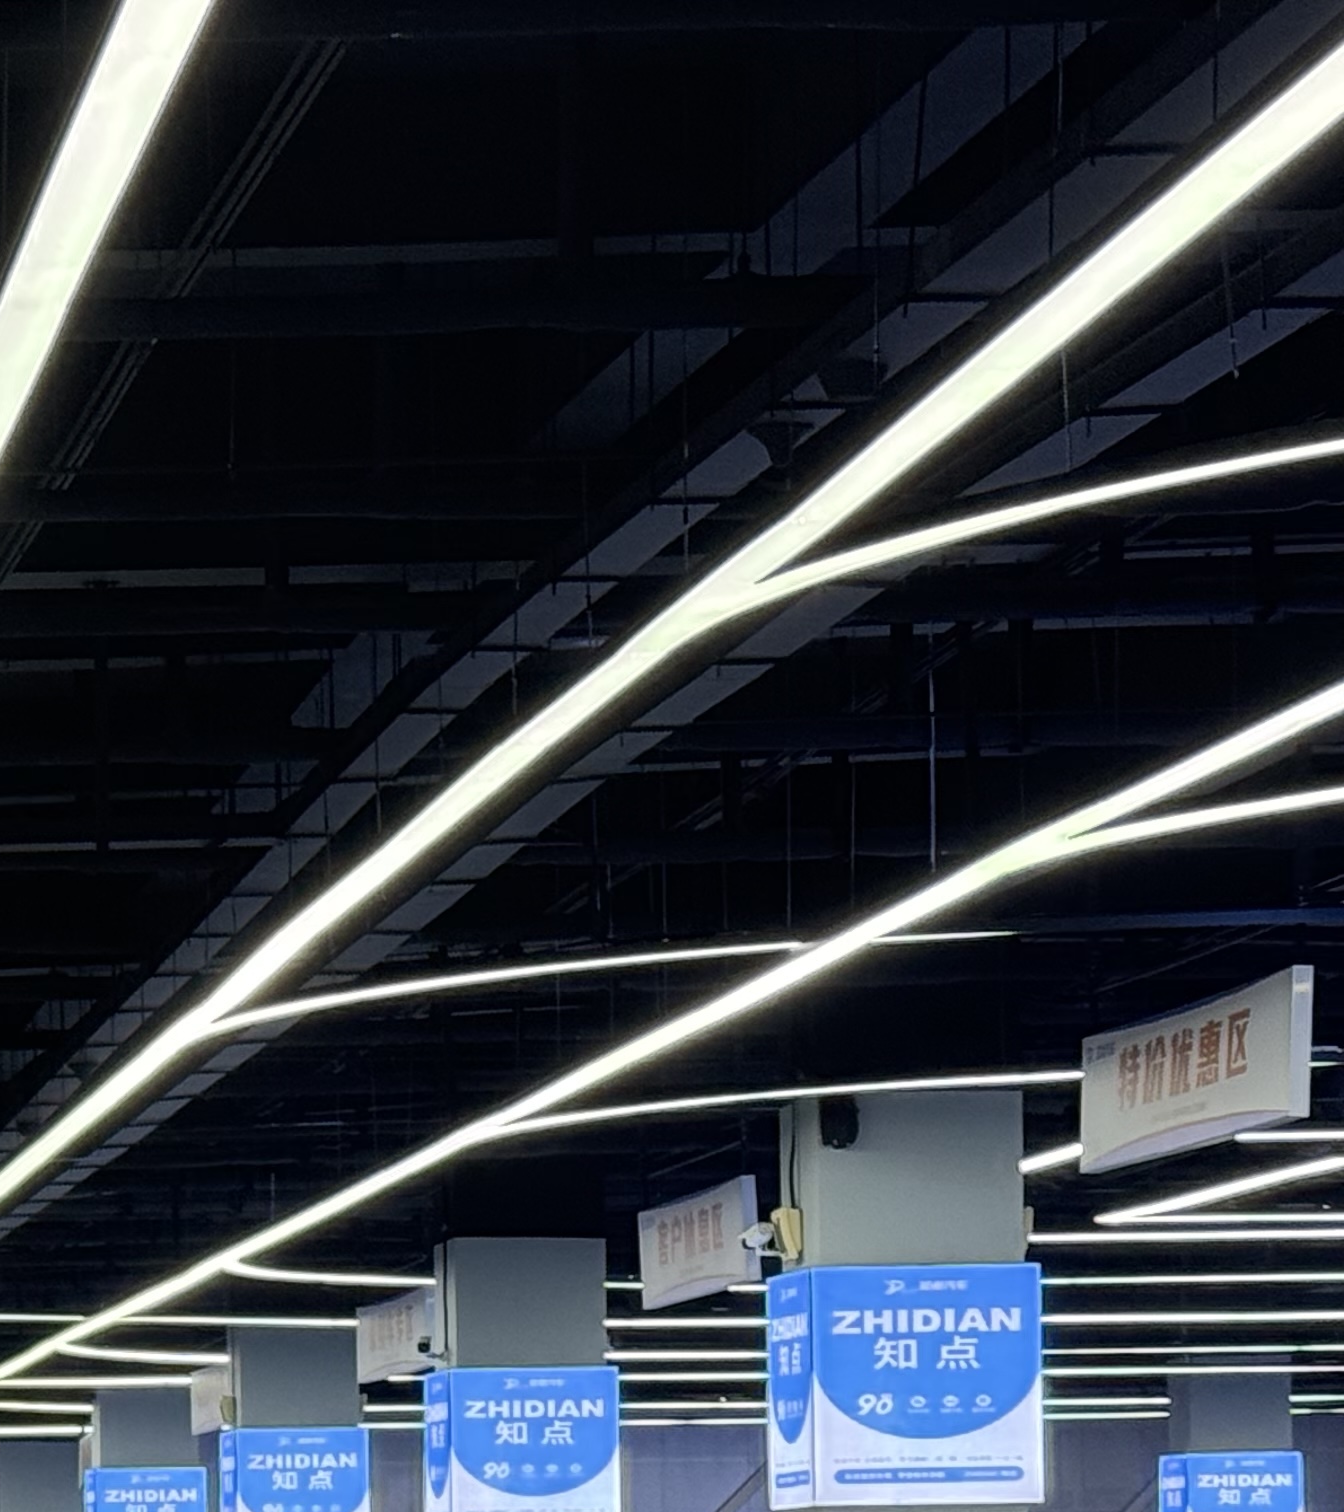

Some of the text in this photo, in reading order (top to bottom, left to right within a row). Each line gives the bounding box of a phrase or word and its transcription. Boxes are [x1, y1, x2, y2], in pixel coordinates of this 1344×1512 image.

[1118, 1007, 1251, 1112] 特价优惠区
[832, 1307, 1021, 1335] ZHIDIAN
[874, 1336, 981, 1370] 知点
[464, 1398, 604, 1418] ZHIDIAN
[495, 1420, 575, 1445] 知点
[247, 1452, 358, 1470] ZHIDIAN
[272, 1470, 334, 1491] 知点
[1197, 1473, 1293, 1488] ZHIDIAN
[104, 1488, 197, 1503] ZHIDIAN
